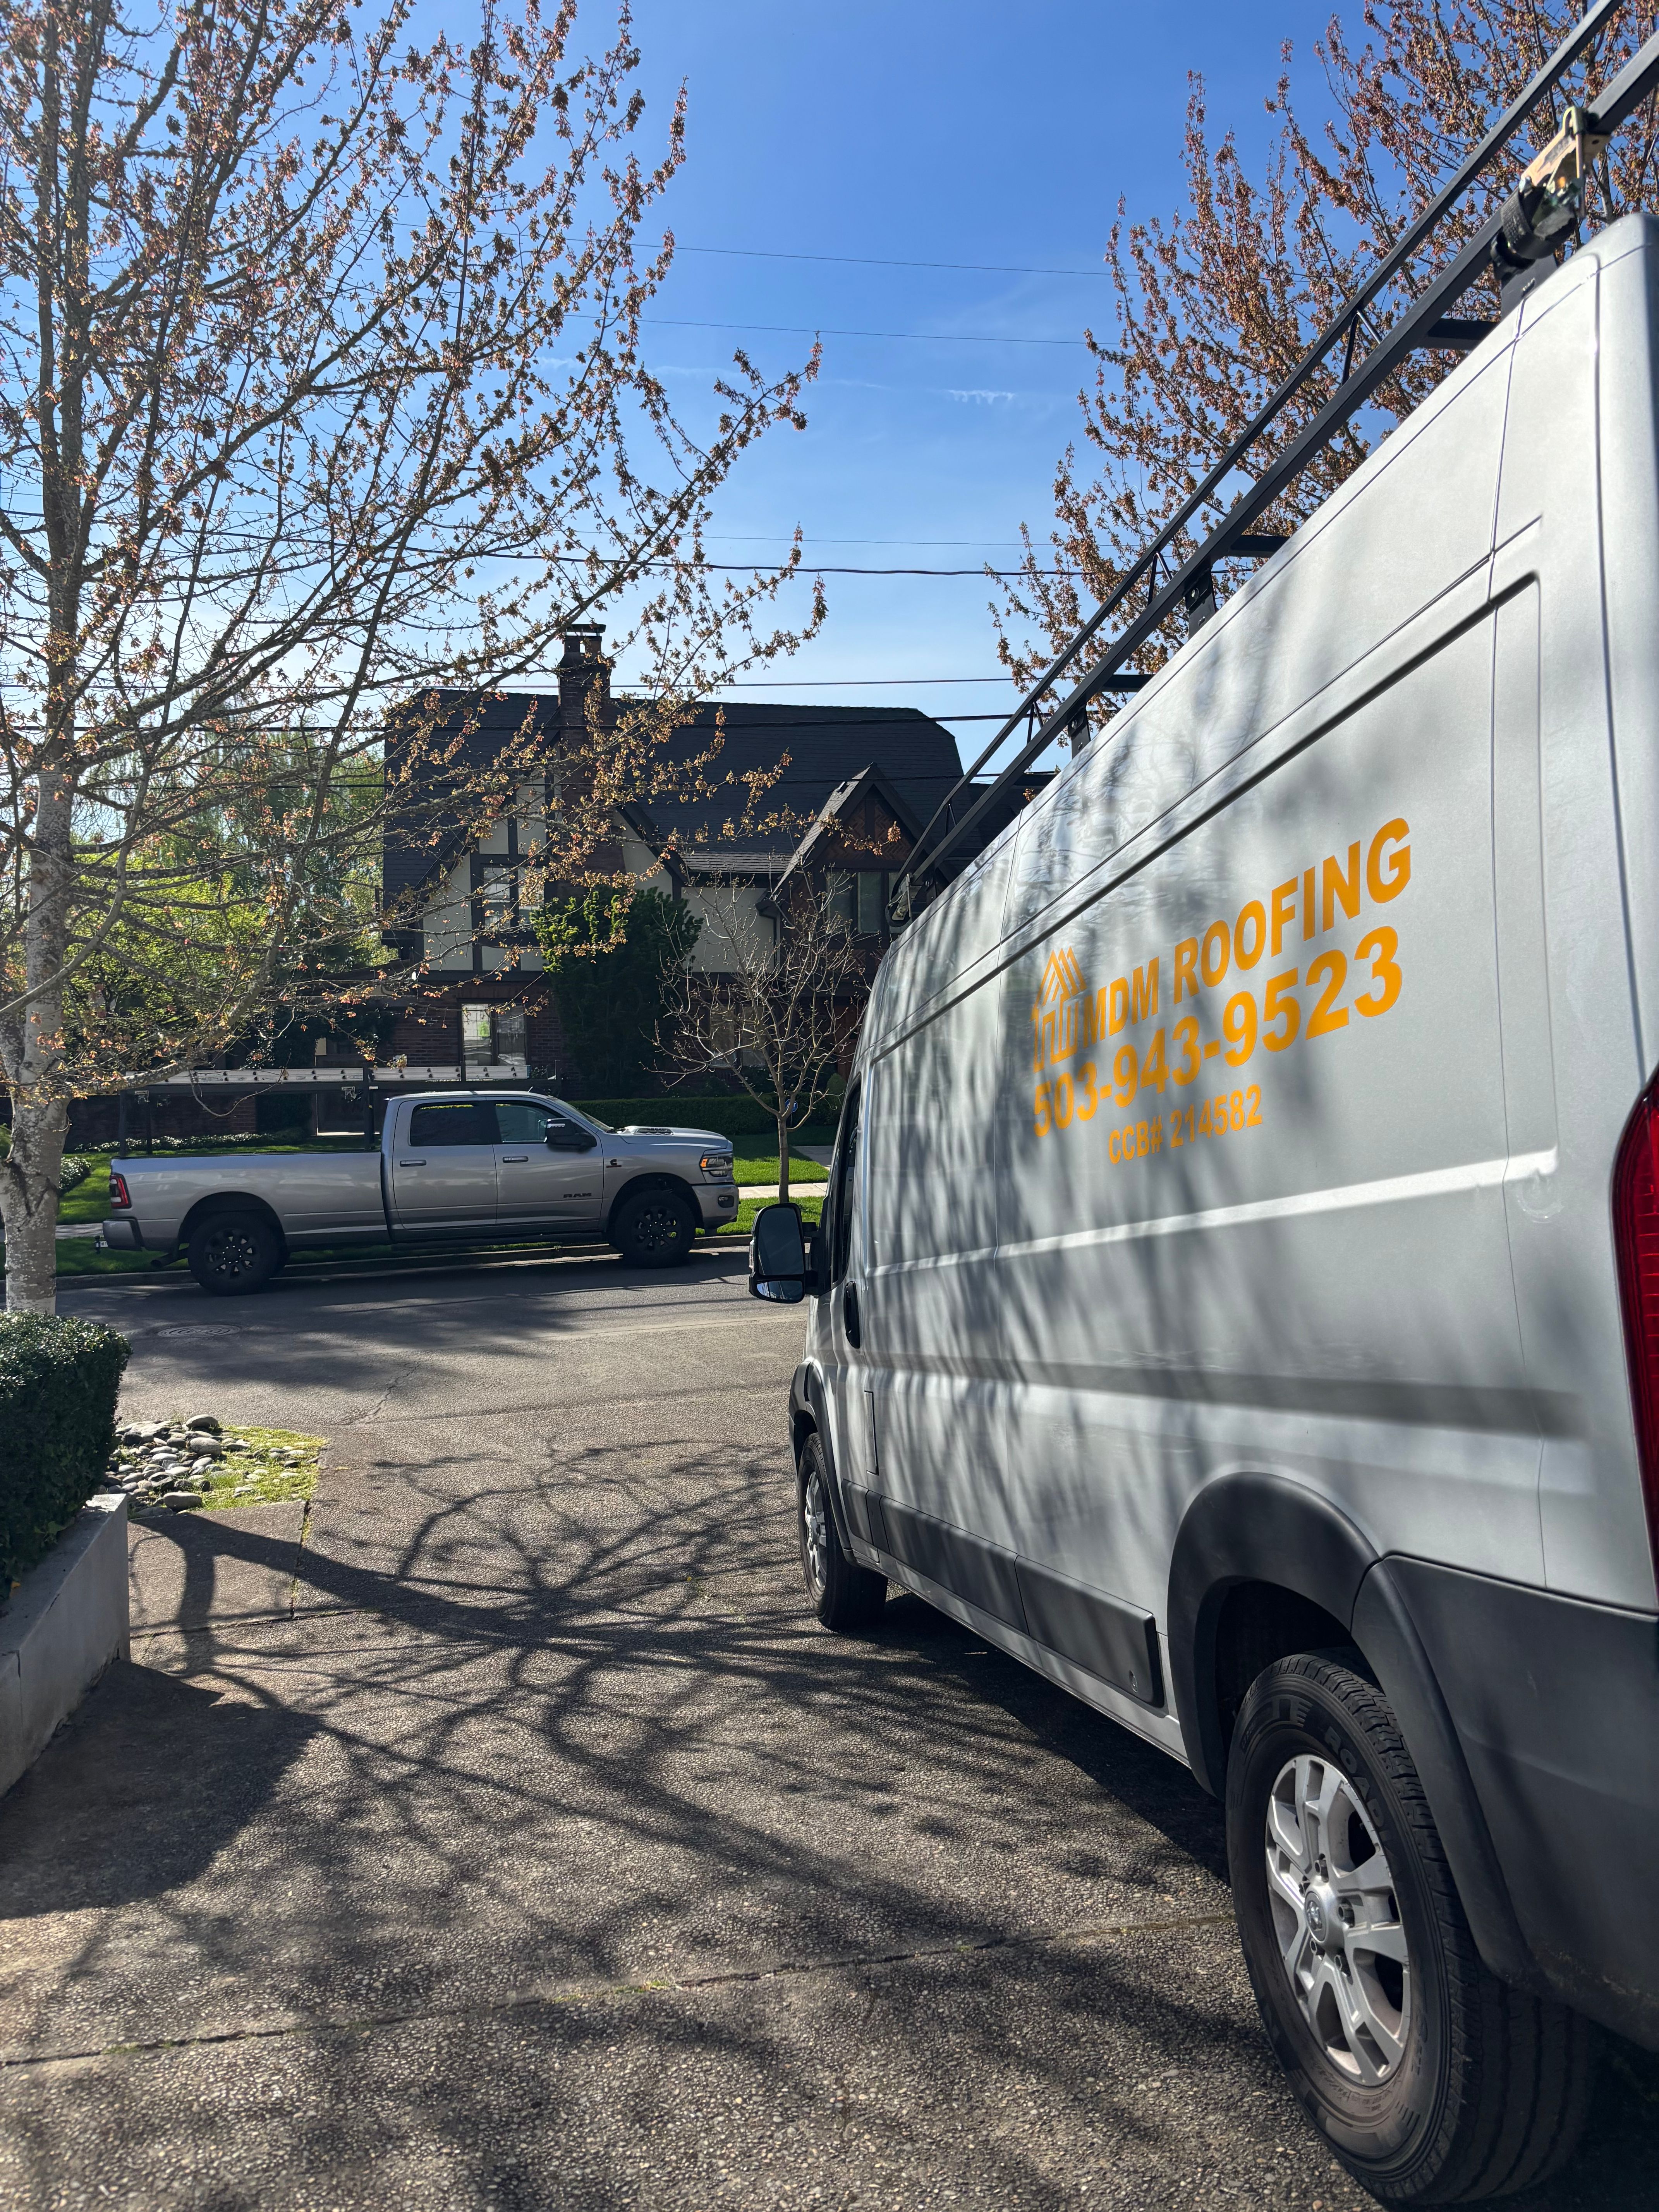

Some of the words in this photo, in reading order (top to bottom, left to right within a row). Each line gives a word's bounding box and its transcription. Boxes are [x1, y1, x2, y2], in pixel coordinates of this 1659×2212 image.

[1033, 926, 1402, 1137] 503-943-9523
[1083, 957, 1159, 1048] MDM
[1173, 818, 1411, 1005] ROOFING
[1108, 1115, 1163, 1164] CCB#
[1170, 1084, 1262, 1148] 214582
